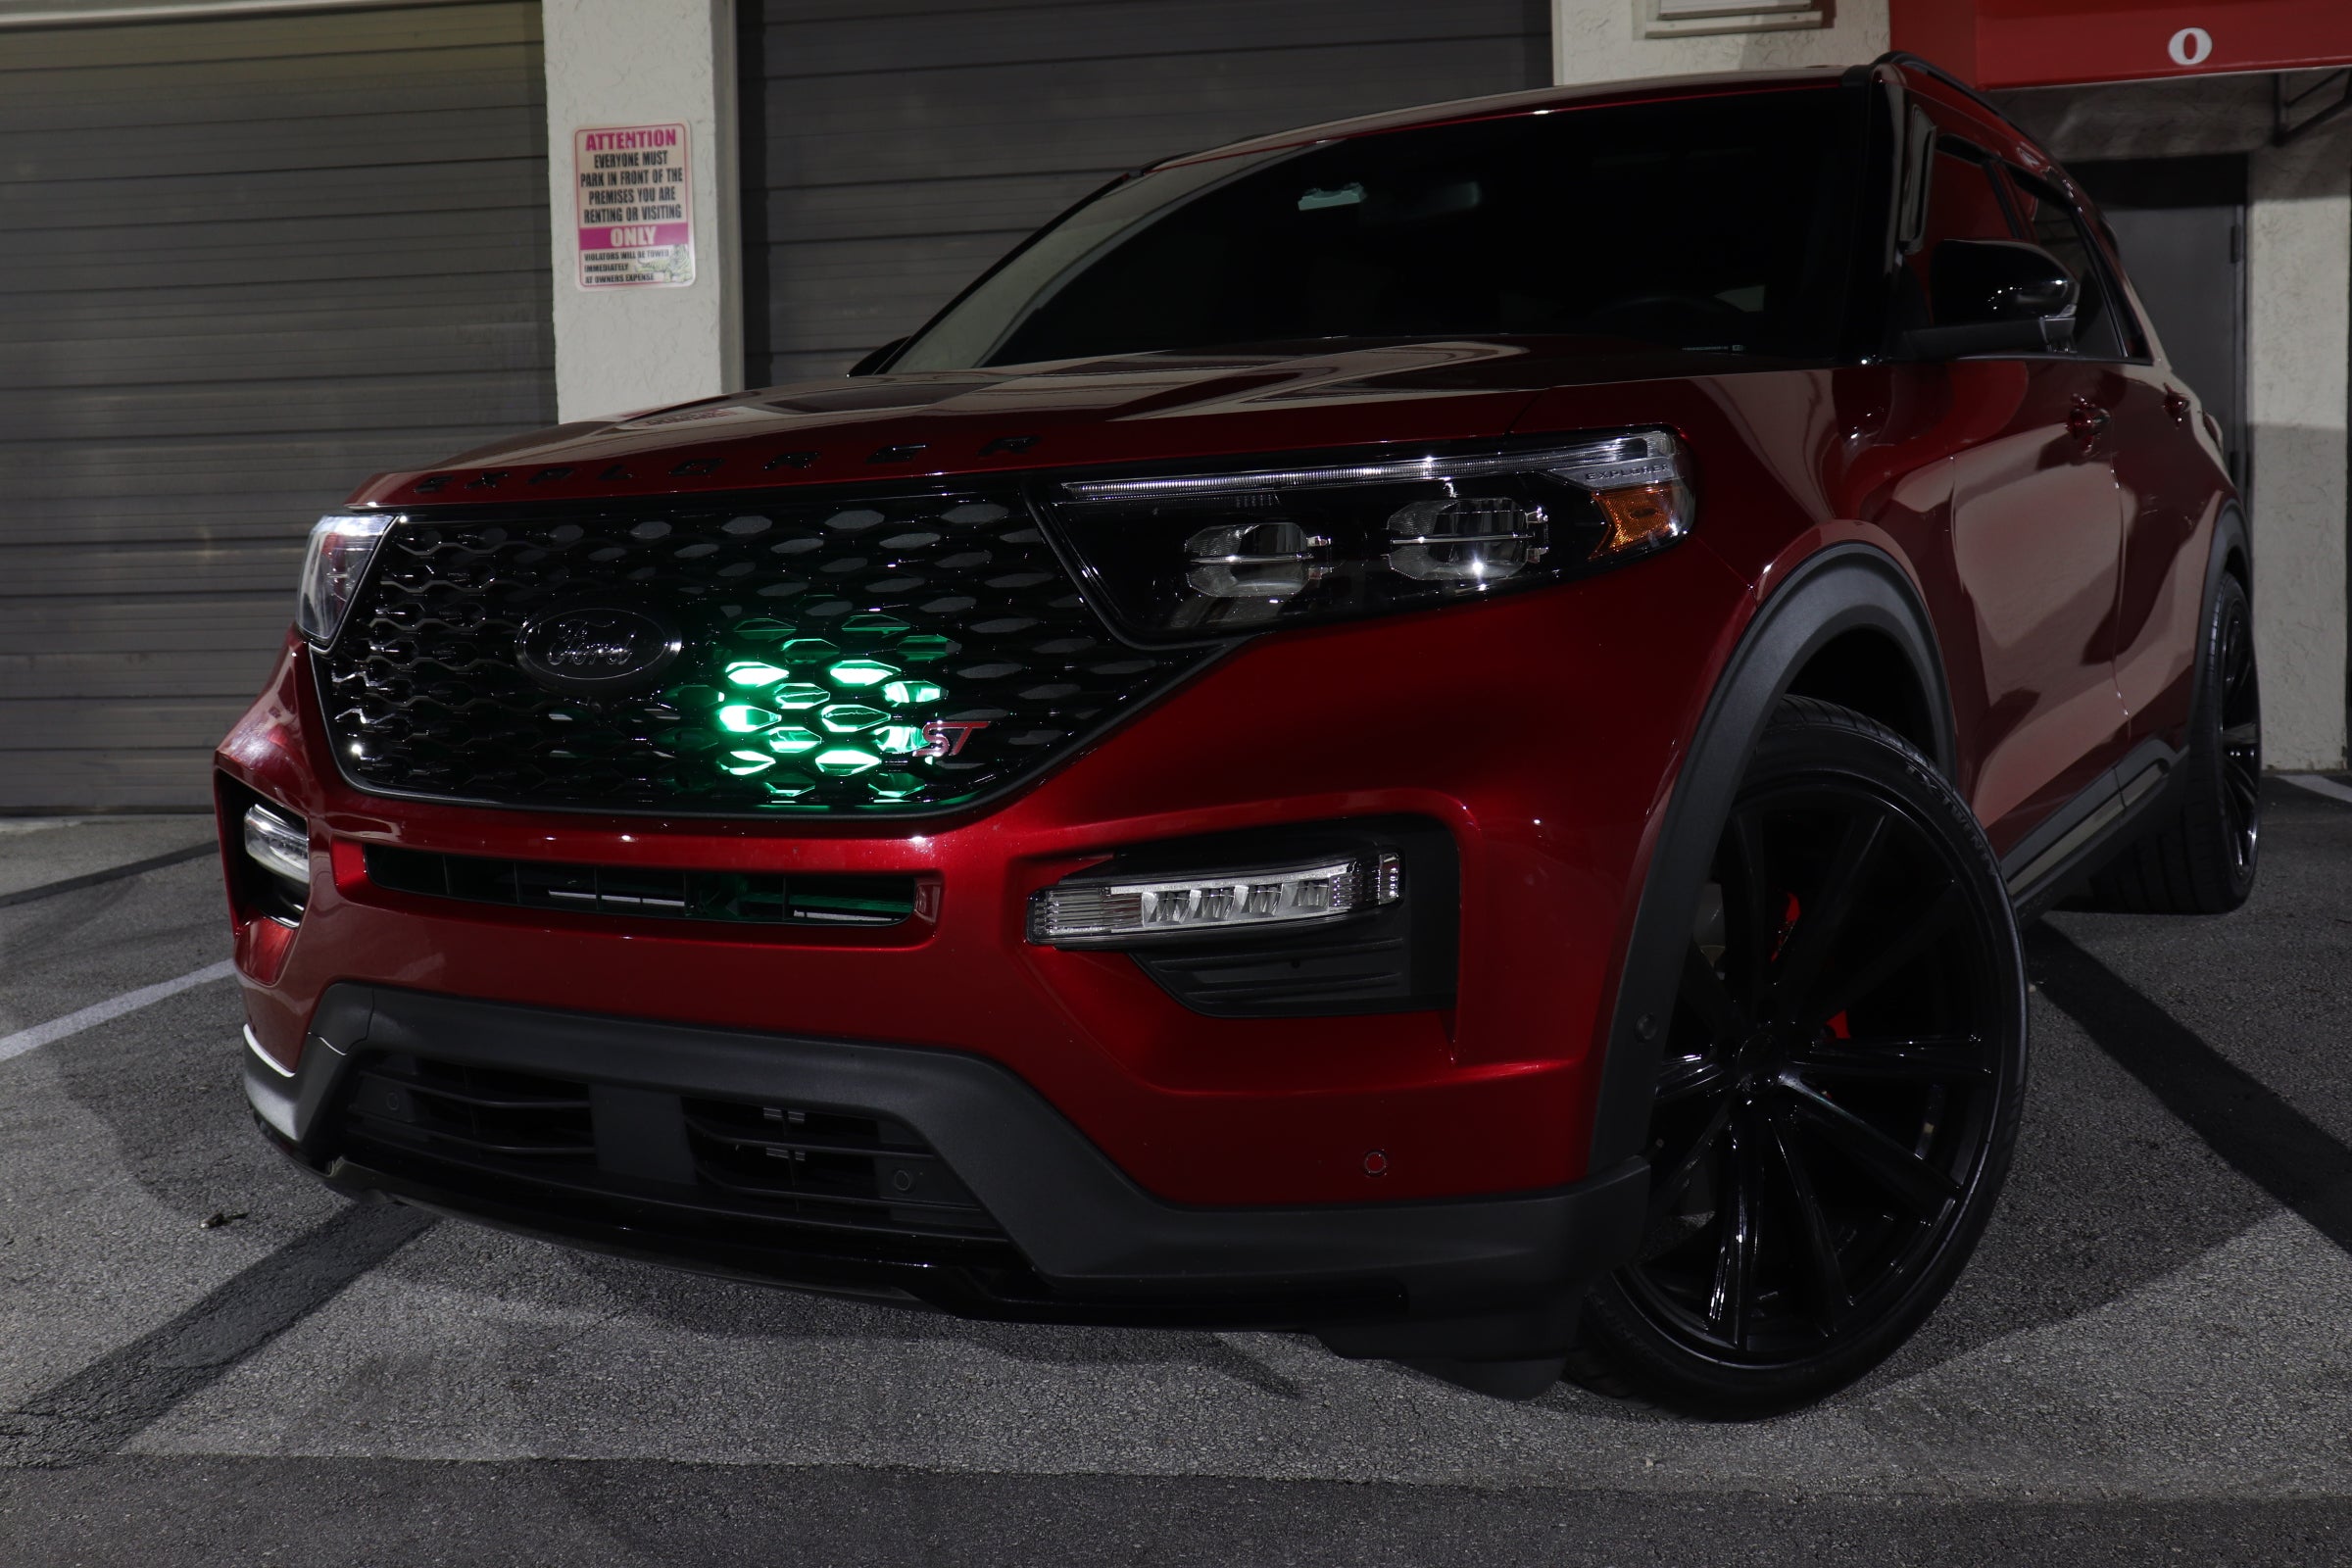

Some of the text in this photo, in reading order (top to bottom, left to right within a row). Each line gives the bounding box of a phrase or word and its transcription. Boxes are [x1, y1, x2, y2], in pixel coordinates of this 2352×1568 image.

[585, 128, 676, 151] ATTENTION
[594, 150, 668, 169] EVERYONE MUST
[580, 167, 683, 187] PARK IN FRONT OF THE
[589, 186, 675, 206] PREMISES YOU ARE
[584, 204, 682, 223] RENTING OR VISITING
[610, 225, 657, 247] ONLY
[584, 249, 669, 262] VIOLATORS WILL BE TOWED
[584, 263, 629, 272] IMMEDIATELY
[585, 272, 654, 284] AT OWNERS EXPENSE
[414, 434, 1042, 494] EXPLORER
[1586, 464, 1669, 480] EXPLORER
[546, 618, 637, 665] Ford
[912, 719, 992, 757] ST
